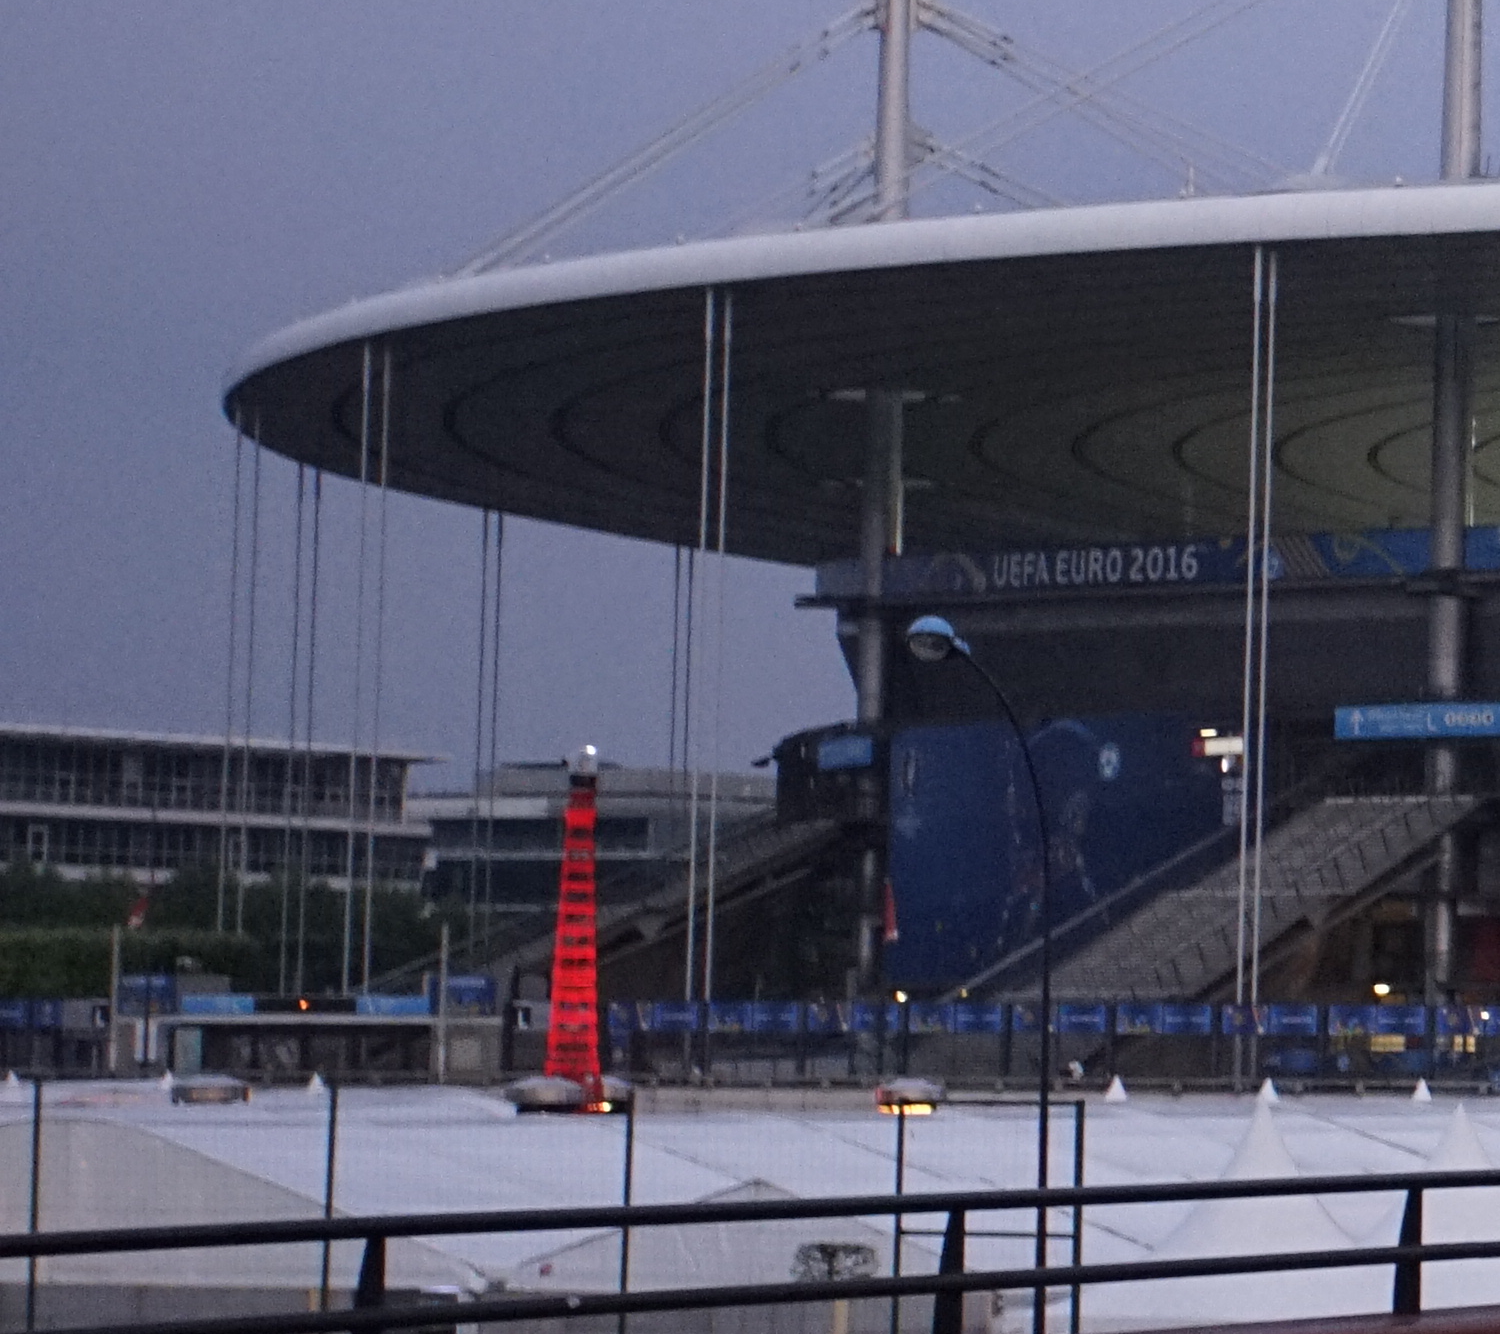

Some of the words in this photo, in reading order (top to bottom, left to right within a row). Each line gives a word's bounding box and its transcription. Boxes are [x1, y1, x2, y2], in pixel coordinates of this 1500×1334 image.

[994, 551, 1050, 588] UEFA
[1055, 547, 1123, 585] EURO
[1129, 544, 1199, 582] 2016
